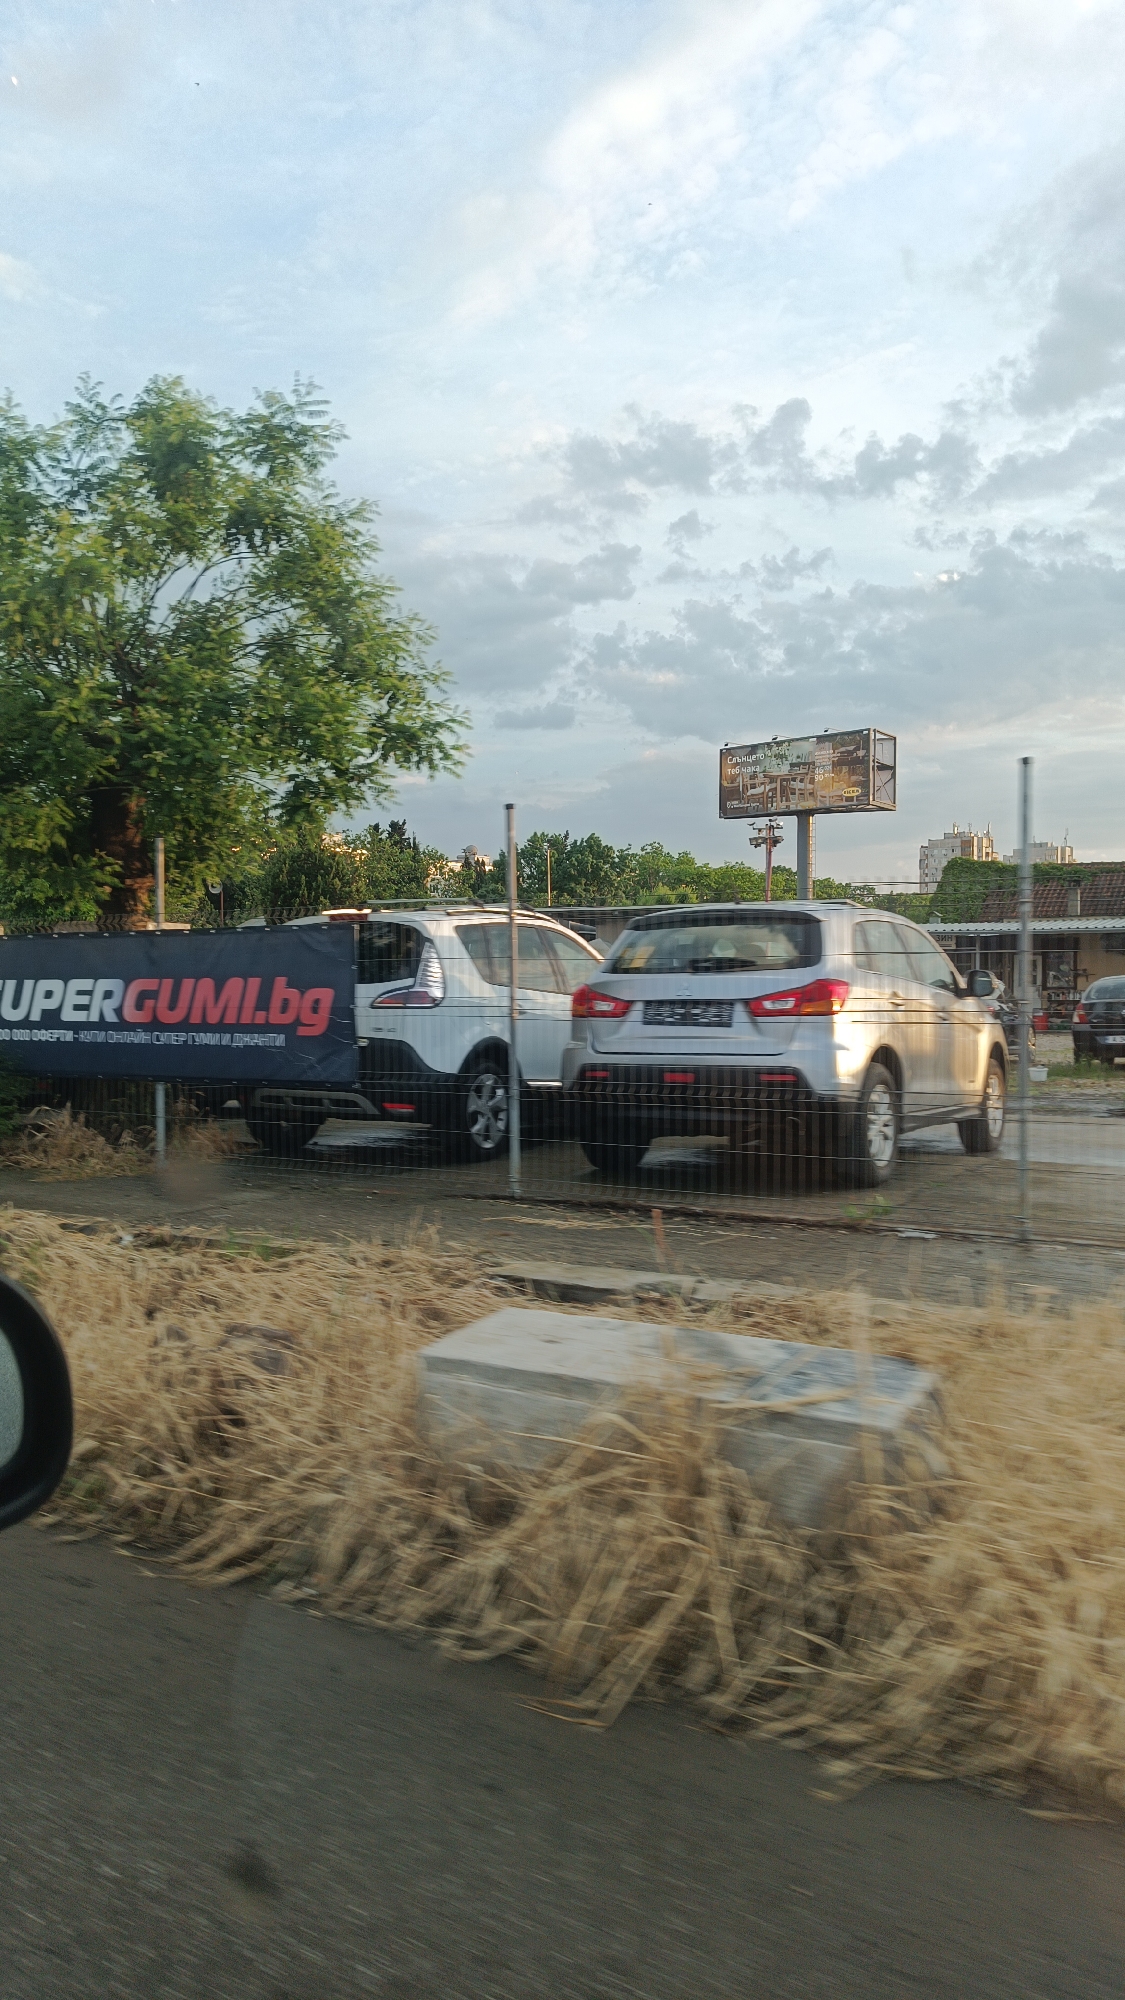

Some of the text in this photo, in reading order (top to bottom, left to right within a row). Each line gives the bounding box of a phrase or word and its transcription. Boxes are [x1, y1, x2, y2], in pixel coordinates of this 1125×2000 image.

[727, 753, 765, 764] Слънцето
[727, 765, 760, 775] теб чака
[0, 976, 335, 1036] UPERGUMI.bg
[32, 1028, 74, 1042] ОФЕРТИ
[107, 1028, 151, 1045] ОНЛАЙН
[231, 1033, 286, 1049] ДЖАНТИ
